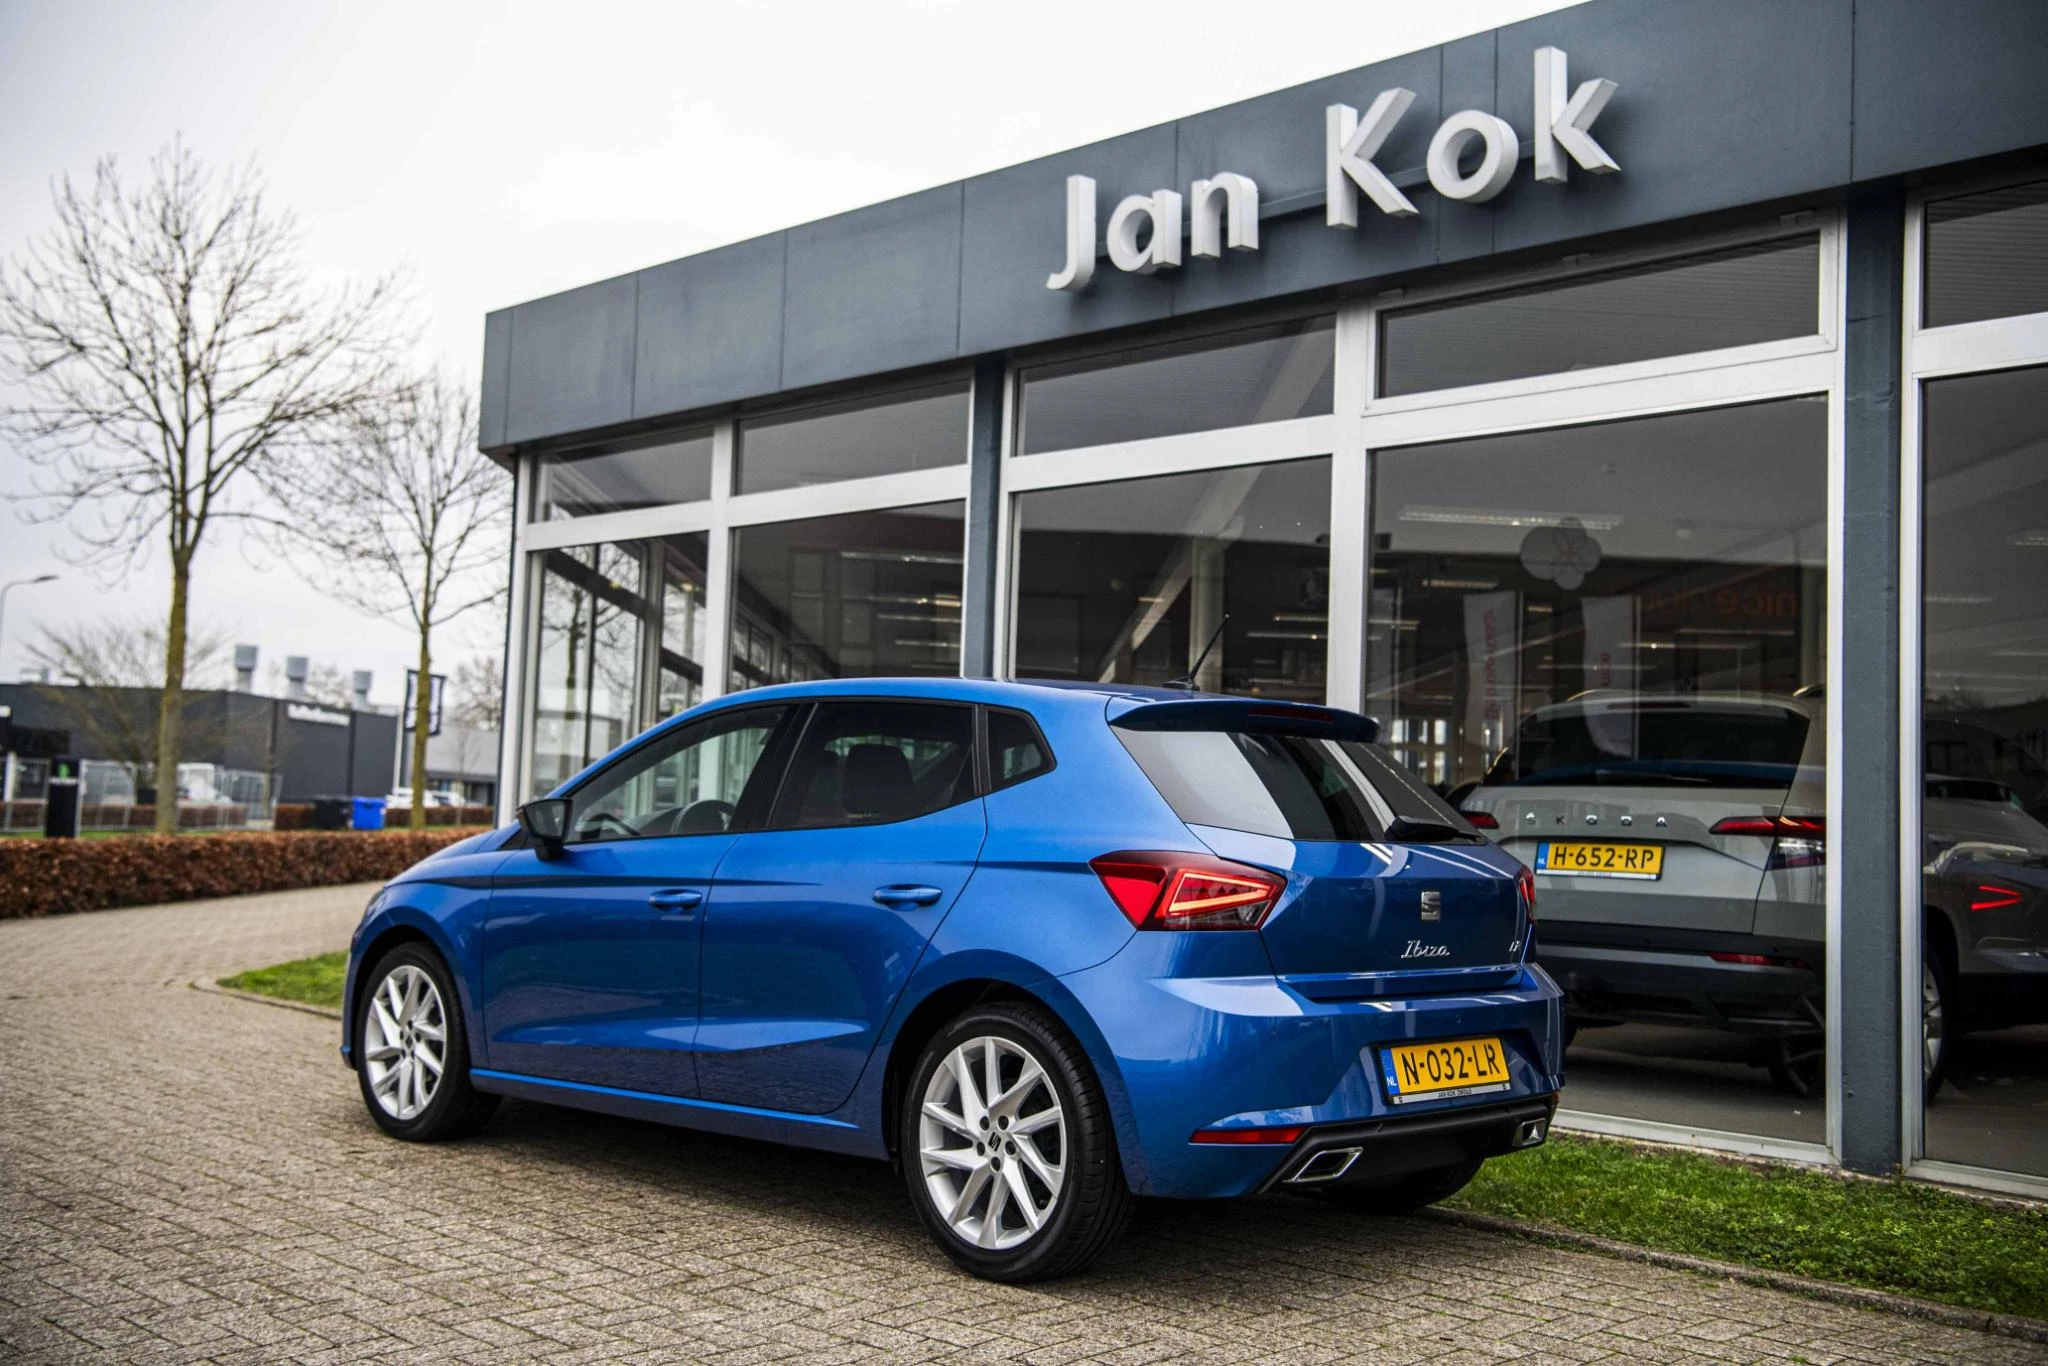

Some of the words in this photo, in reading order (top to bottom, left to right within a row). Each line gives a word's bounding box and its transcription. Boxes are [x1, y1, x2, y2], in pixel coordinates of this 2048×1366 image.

[1046, 171, 1259, 292] Jan
[1326, 46, 1621, 229] Kok
[1553, 846, 1654, 869] H-652-RP
[1401, 940, 1450, 958] Ibiza
[1401, 1043, 1501, 1086] N-032-LR
[1386, 1076, 1397, 1087] NL
